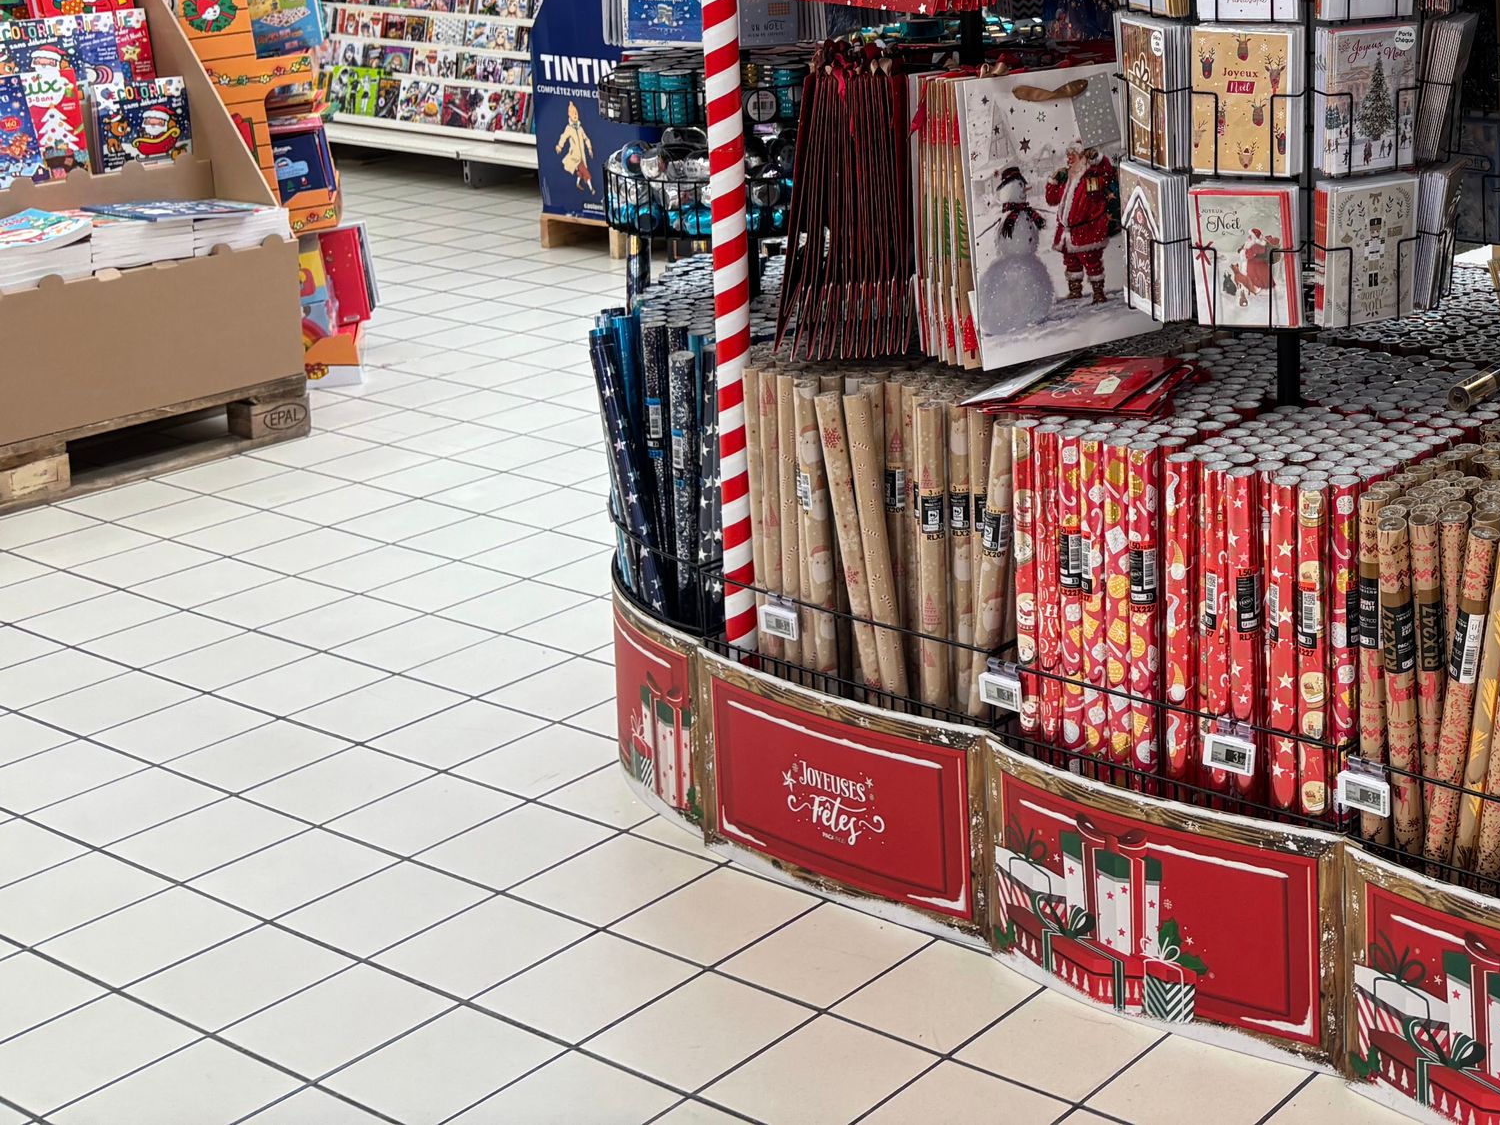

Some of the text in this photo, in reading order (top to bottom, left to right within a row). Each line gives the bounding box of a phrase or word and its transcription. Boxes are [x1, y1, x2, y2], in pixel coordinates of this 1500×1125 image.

[1398, 30, 1413, 39] Porte
[1347, 39, 1384, 63] Joyeux
[540, 53, 617, 85] TINTIN
[1222, 67, 1259, 79] Joyeux
[117, 79, 171, 101] COLORIE
[537, 84, 592, 98] COMPLÉTEZ VOTRE
[1383, 609, 1398, 671] RLX247
[1422, 605, 1438, 669] RLX247
[798, 759, 867, 803] JOYEUSES
[808, 793, 868, 846] Fêtes
